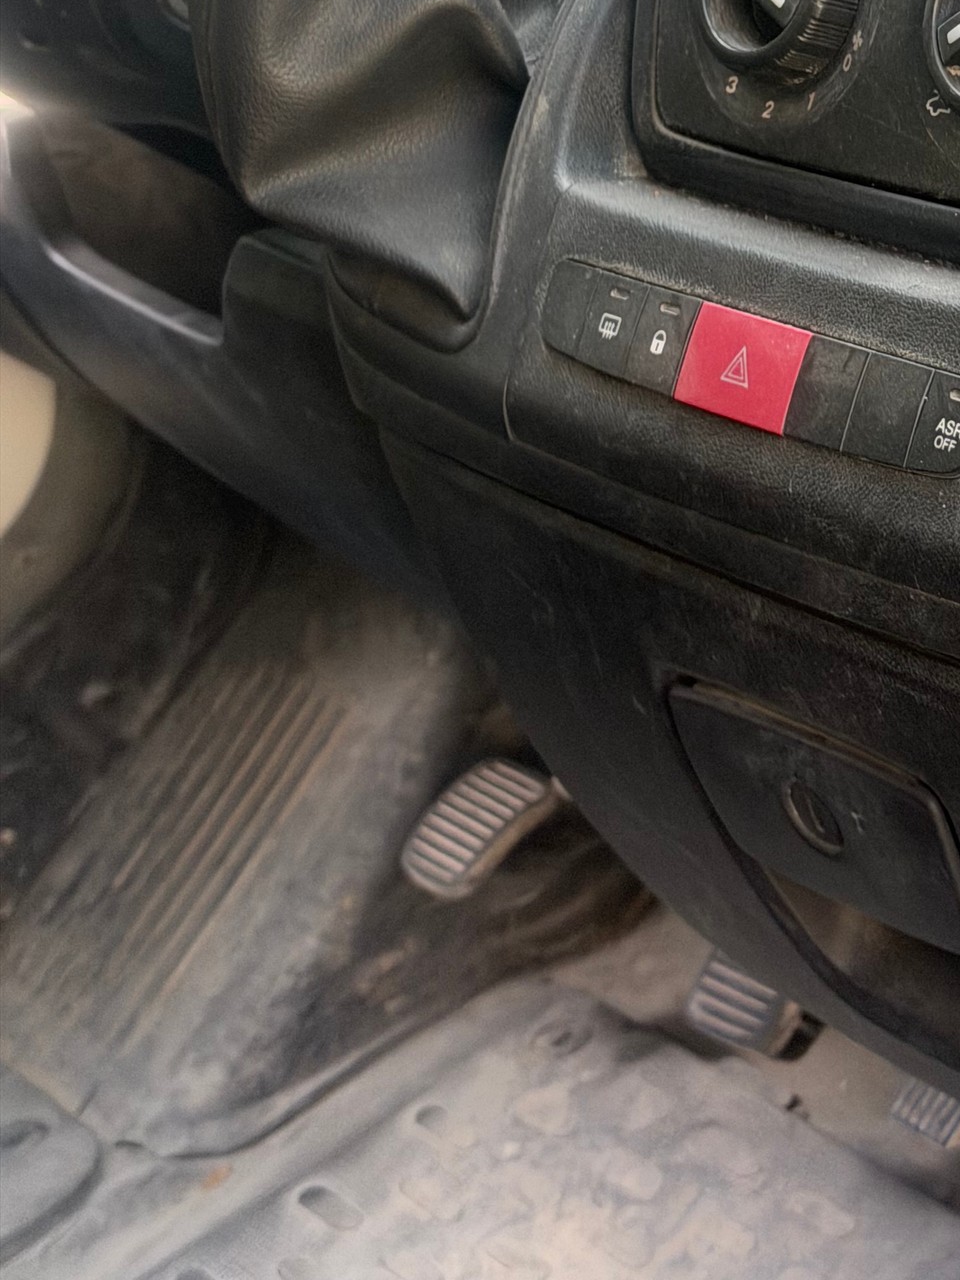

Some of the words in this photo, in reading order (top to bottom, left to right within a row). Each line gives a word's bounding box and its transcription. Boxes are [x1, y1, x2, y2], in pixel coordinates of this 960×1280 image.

[725, 75, 739, 94] 3
[761, 100, 775, 119] 2
[807, 91, 816, 111] 1
[933, 435, 958, 453] OFF
